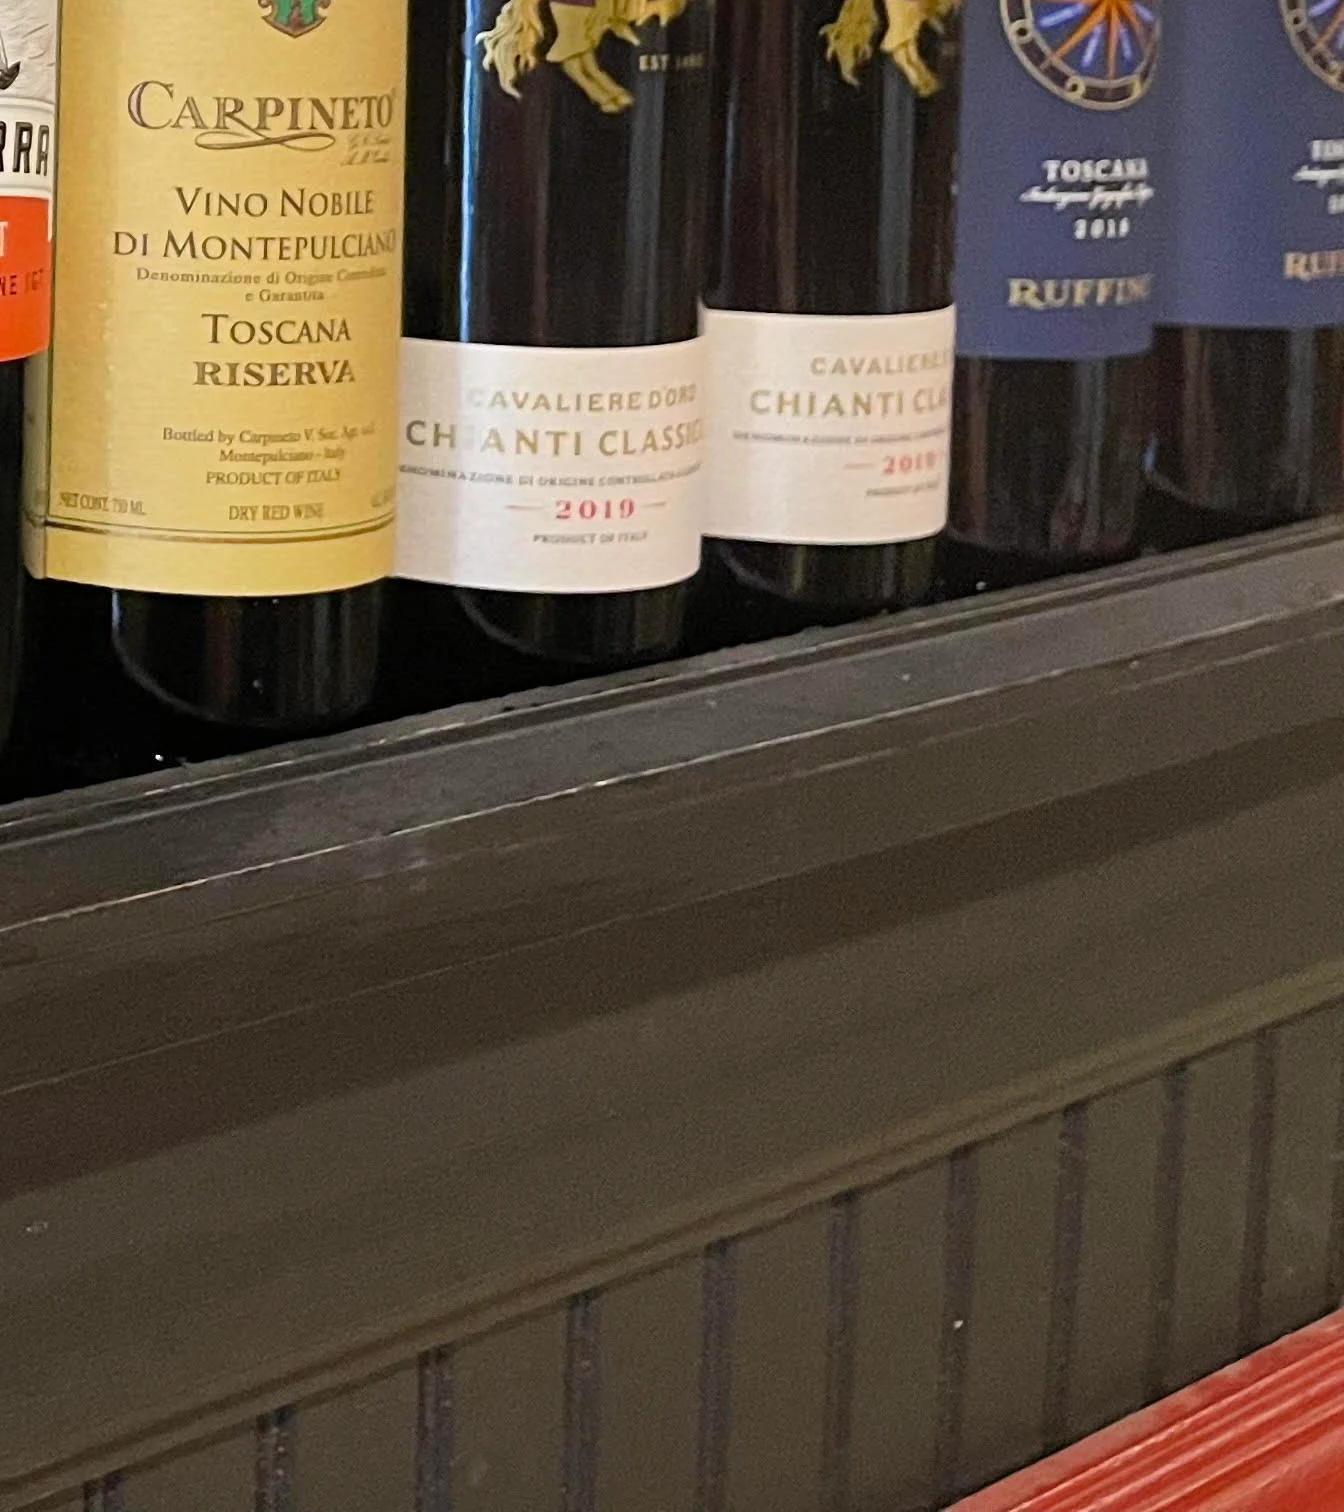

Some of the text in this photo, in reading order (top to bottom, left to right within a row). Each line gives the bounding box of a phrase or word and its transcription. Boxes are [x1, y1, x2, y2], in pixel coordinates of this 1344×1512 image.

[127, 80, 394, 146] CARPINETO
[174, 186, 375, 217] VINO NOBILE
[113, 228, 398, 261] DI MONTEPULCIANO
[136, 267, 262, 285] Denominazione
[266, 268, 280, 285] di
[1007, 272, 1154, 310] RUFFIN
[201, 313, 352, 345] TOSCANA
[192, 359, 357, 387] RISERVA
[466, 390, 642, 413] CAVALIERE
[750, 389, 904, 417] CHIANTI
[405, 419, 582, 457] CHANTI
[206, 470, 283, 486] PRODUCT
[284, 469, 305, 485] OF
[228, 504, 258, 521] DRY
[262, 504, 290, 520] RED
[554, 498, 635, 521] 2019
